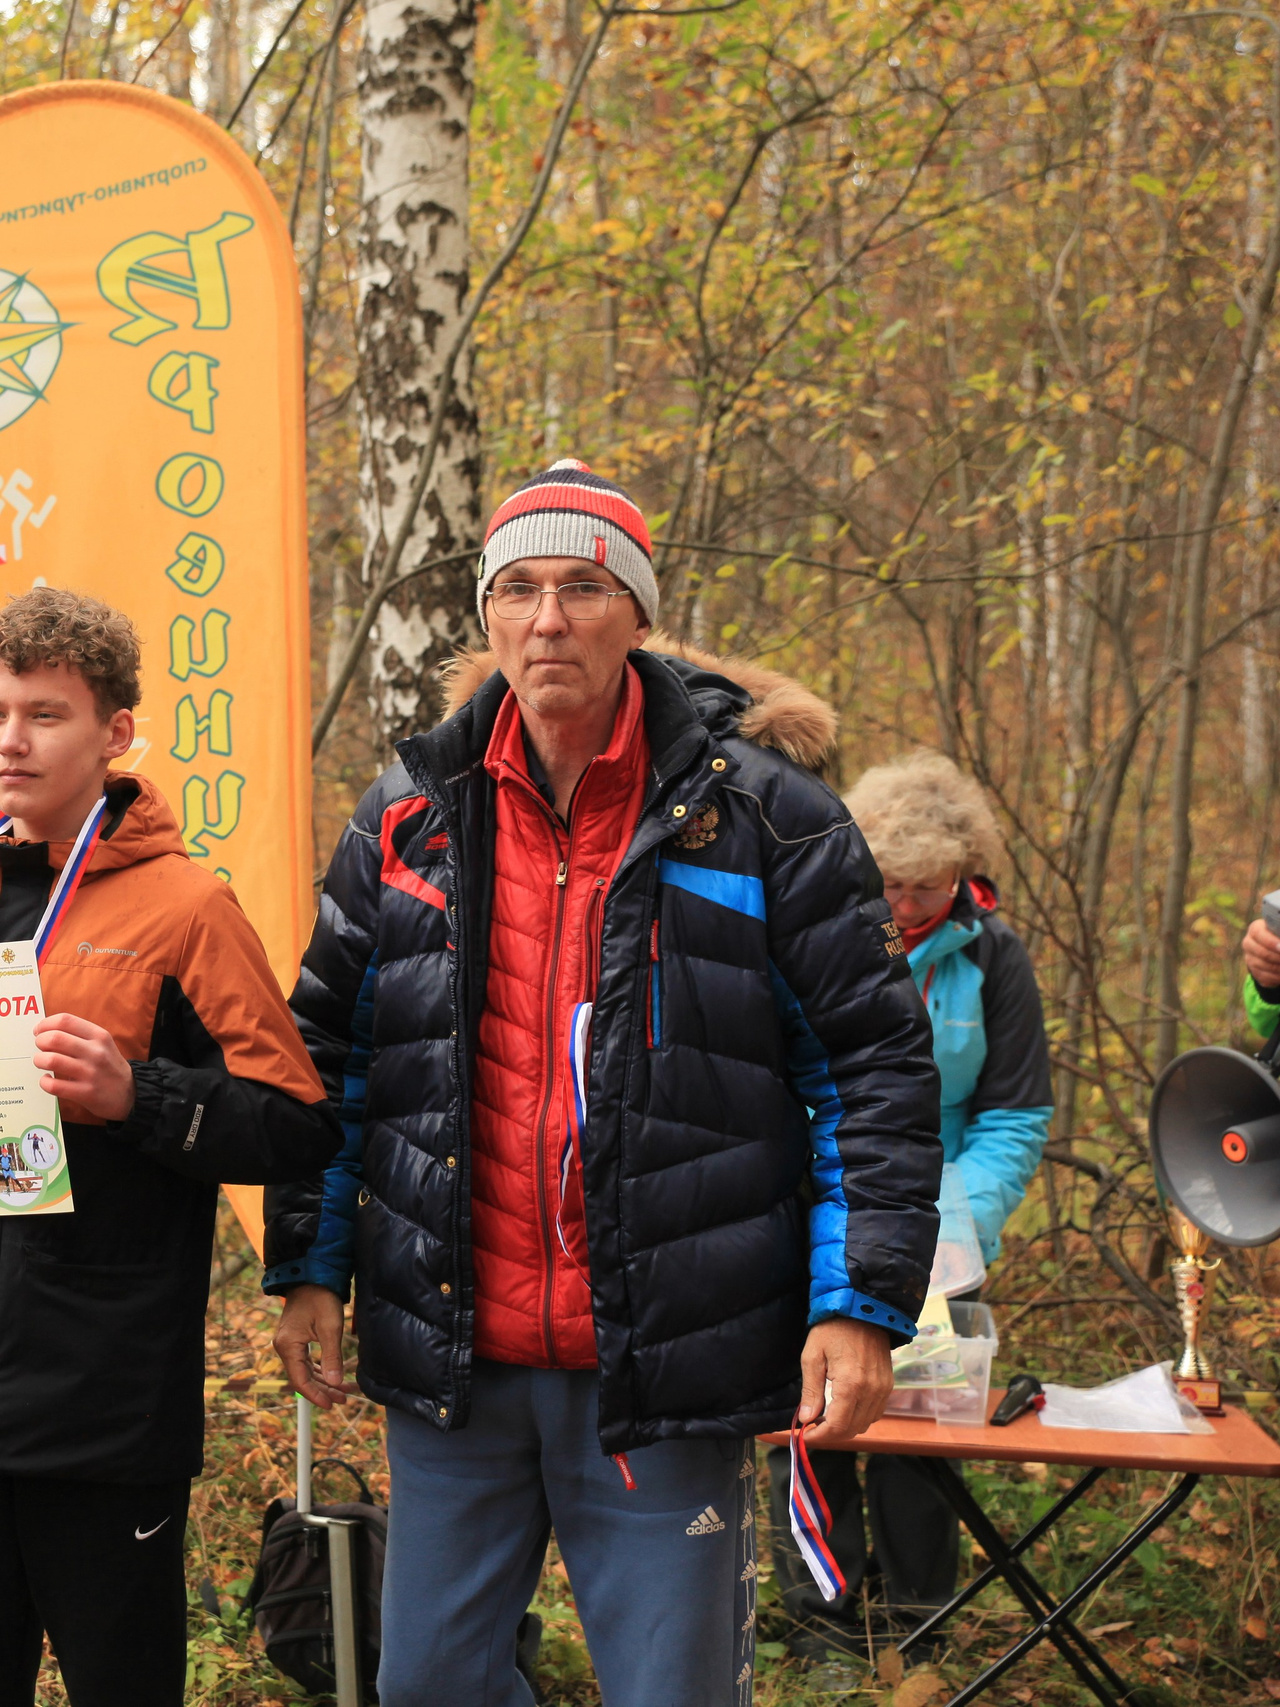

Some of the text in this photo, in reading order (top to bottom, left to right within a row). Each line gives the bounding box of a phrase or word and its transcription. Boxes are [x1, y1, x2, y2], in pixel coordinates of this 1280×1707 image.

[95, 948, 138, 956] OUTVENTURE
[618, 1458, 632, 1484] FORWARD
[686, 1520, 726, 1536] adidas
